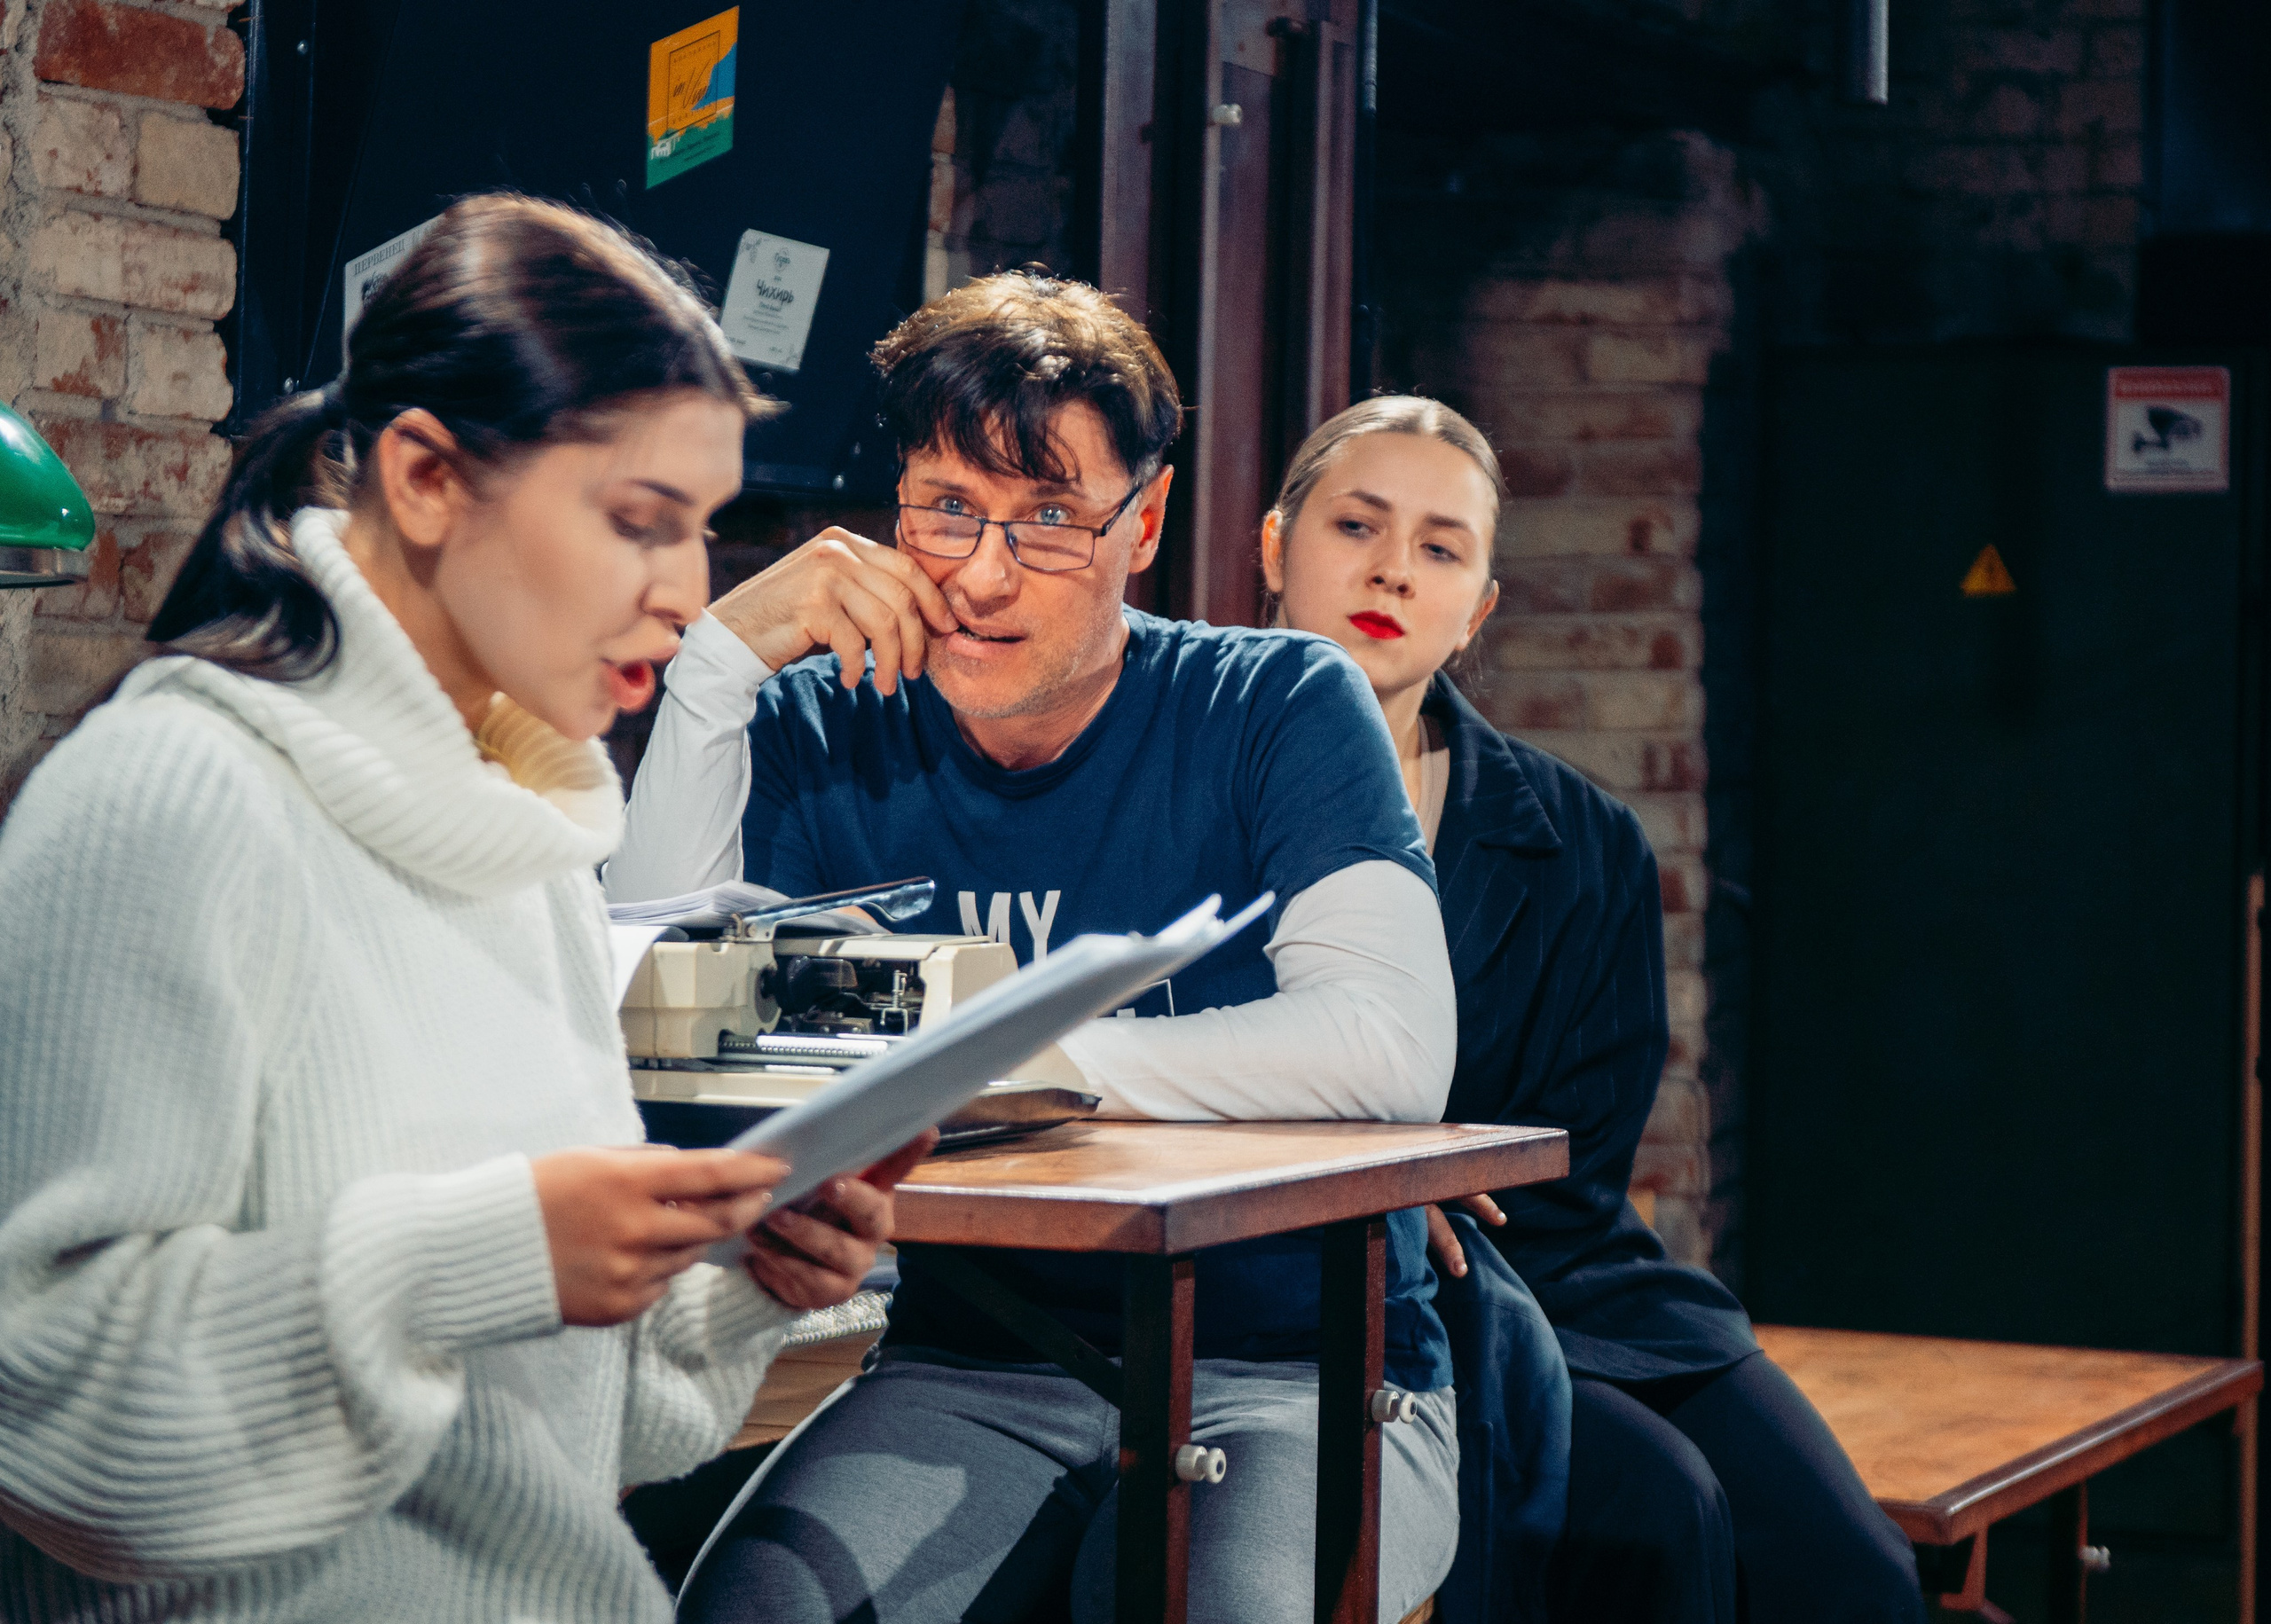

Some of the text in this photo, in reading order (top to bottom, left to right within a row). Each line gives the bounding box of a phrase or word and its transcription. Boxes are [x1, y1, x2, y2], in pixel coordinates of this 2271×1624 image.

[354, 239, 405, 277] ПЕРВЕНЕЦ
[757, 279, 794, 306] Чихирь
[958, 890, 1061, 965] MY
